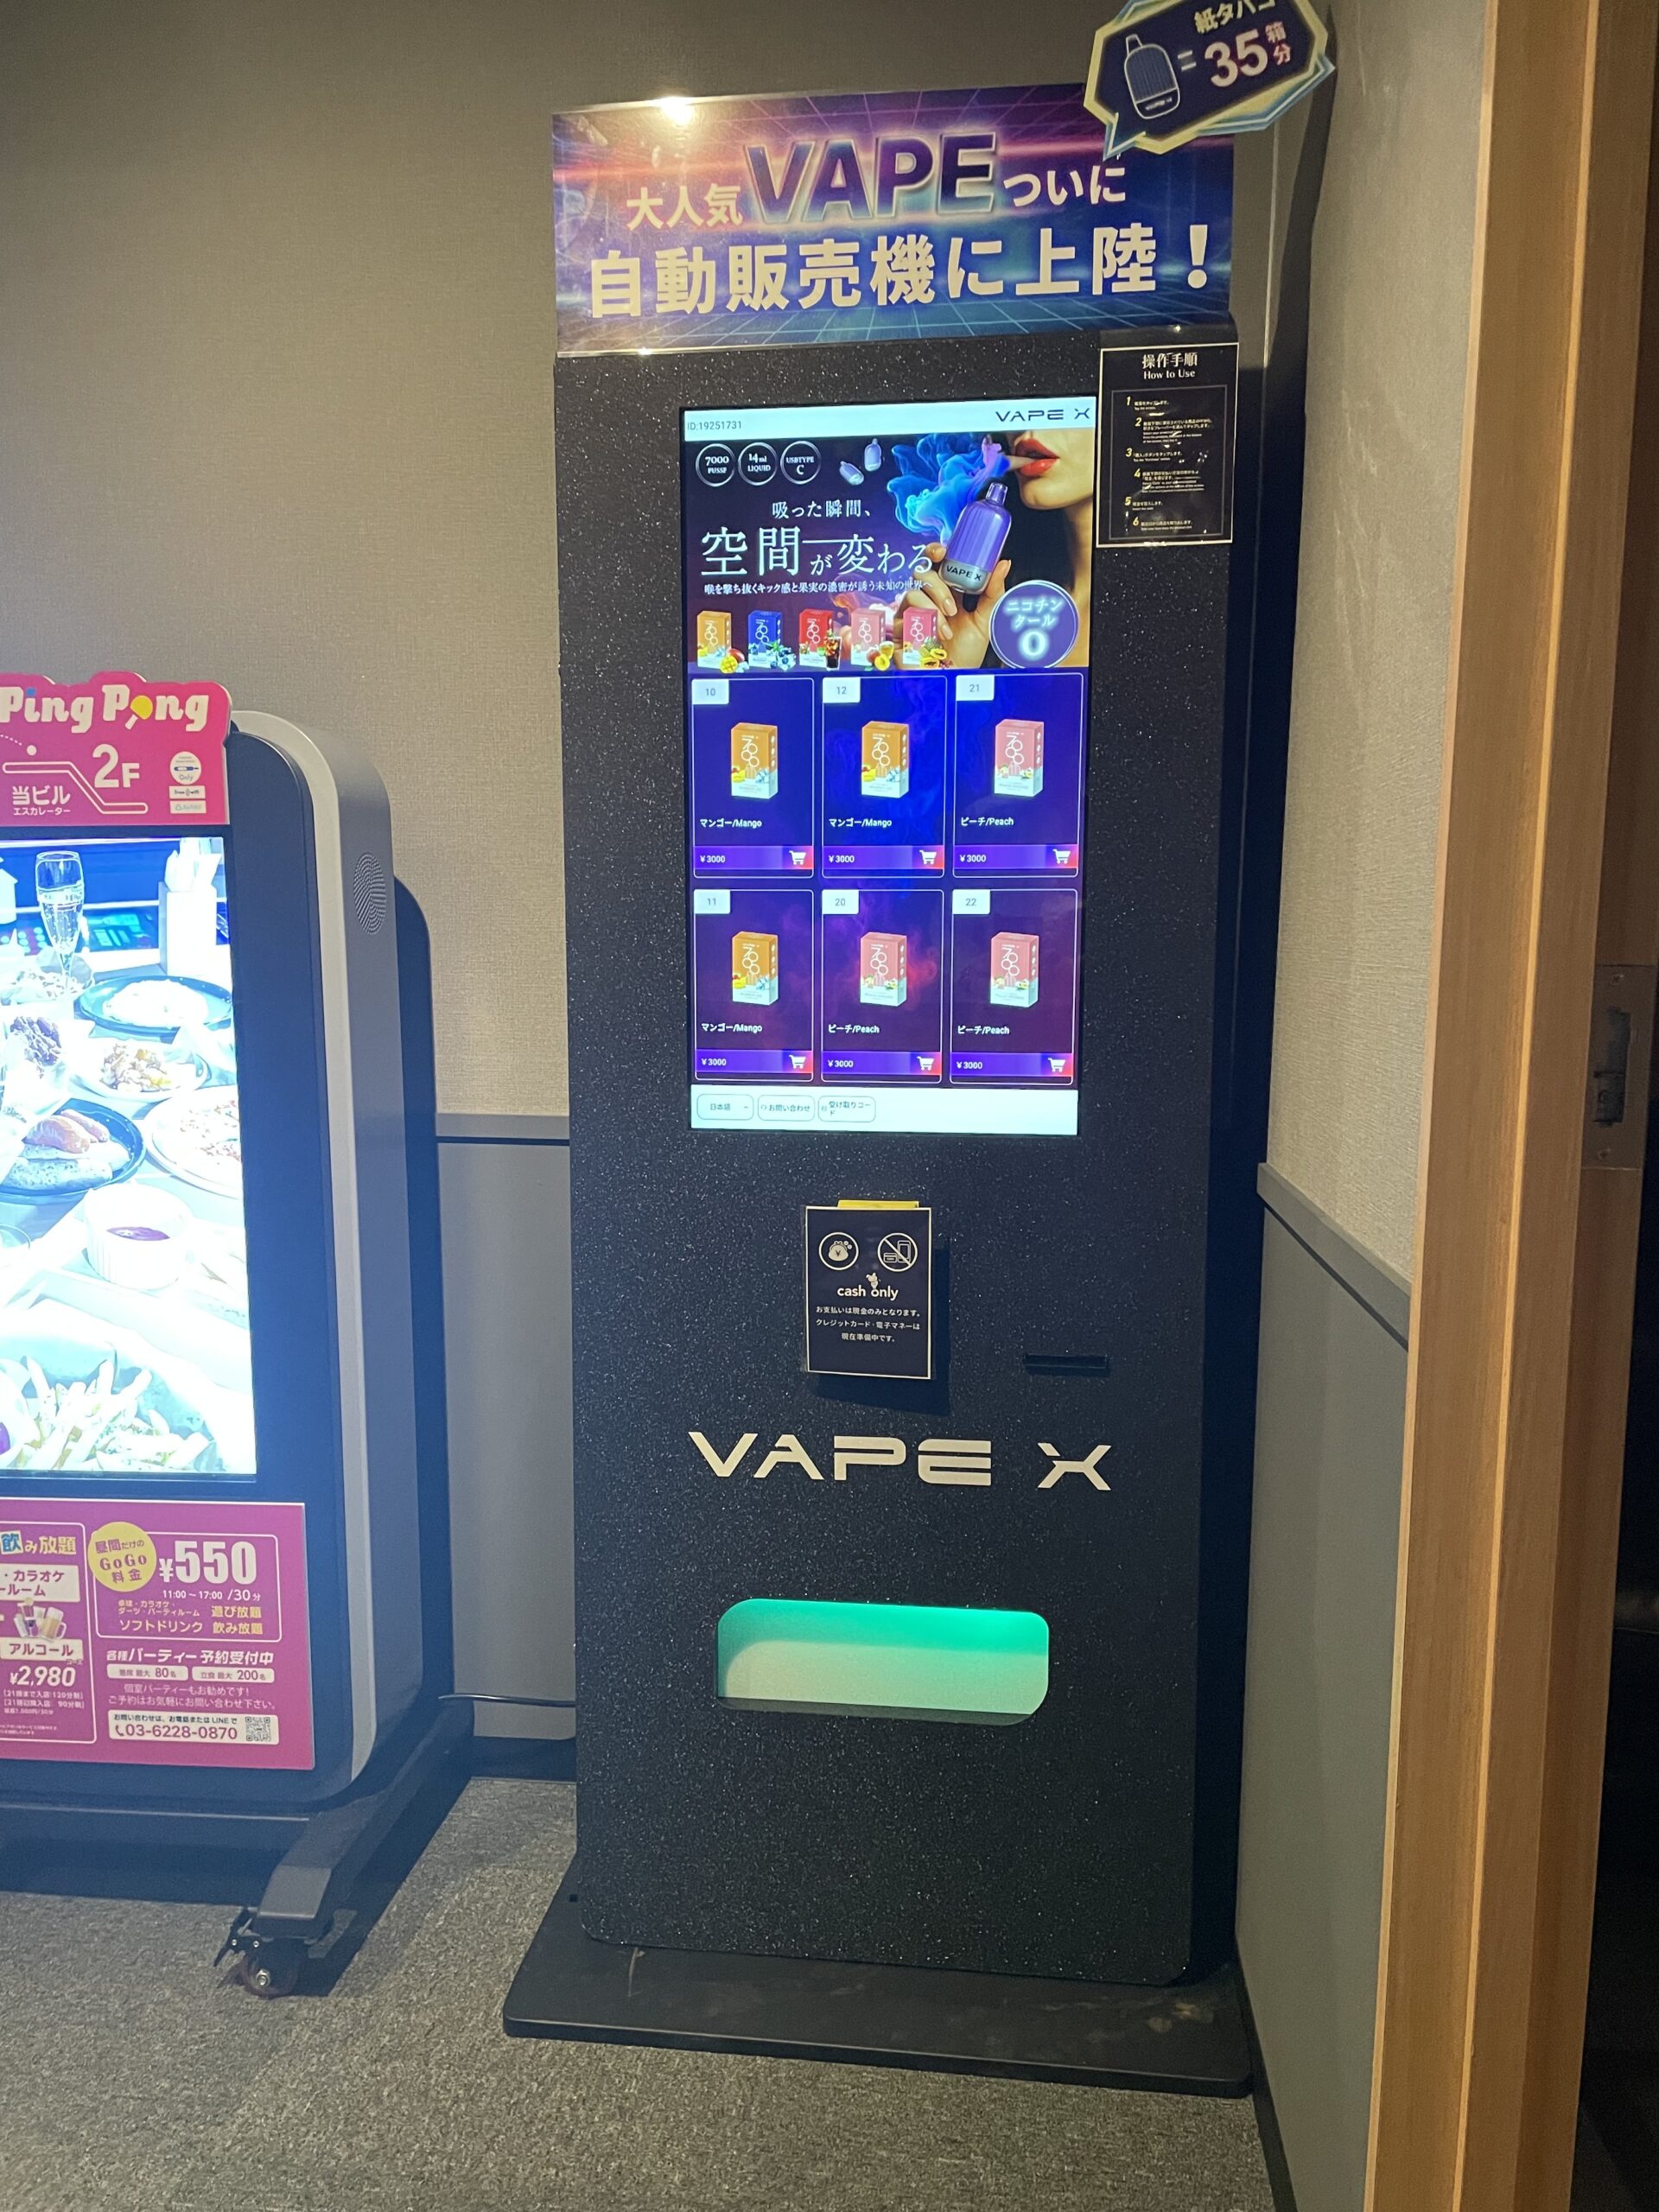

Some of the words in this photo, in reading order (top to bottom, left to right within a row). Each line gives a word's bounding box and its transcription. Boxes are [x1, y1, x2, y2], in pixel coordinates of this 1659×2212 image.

[1205, 29, 1268, 86] 35
[626, 184, 744, 232] 大人気
[743, 131, 998, 225] VAPE
[1004, 164, 1127, 208] ついに
[590, 222, 1211, 319] 自動販売機に上陸！
[1141, 353, 1198, 369] 操作手順
[1143, 371, 1163, 380] How
[1166, 371, 1175, 379] to
[1178, 369, 1196, 378] Use
[1127, 396, 1131, 406] 1
[687, 420, 742, 431] ID:19251731
[995, 409, 1065, 423] VAPE
[1074, 407, 1090, 420] X
[1135, 417, 1142, 427] 2
[1126, 448, 1133, 457] 3
[705, 455, 730, 466] 7000
[796, 465, 804, 474] C
[1134, 468, 1141, 478] 4
[1124, 497, 1132, 505] 5
[772, 499, 871, 519] 吸った瞬間、
[1133, 517, 1140, 526] 6
[701, 526, 933, 576] 空間が変わる
[946, 564, 973, 579] VAPE
[975, 573, 982, 582] X
[1007, 597, 1064, 613] ニコチン
[1014, 615, 1056, 628] タール
[1021, 631, 1046, 657] 0
[704, 688, 716, 696] 10
[836, 686, 847, 695] 12
[969, 683, 981, 692] 21
[0, 686, 94, 733] Ping
[92, 744, 140, 788] 2F
[12, 785, 71, 805] 当ビル
[13, 807, 71, 816] エスカレーター
[700, 817, 762, 829] マンゴー/Mango
[829, 817, 893, 828] マンゴー/Mango
[960, 816, 1014, 827] ピーチ/Peach
[707, 898, 716, 906] 11
[835, 898, 846, 906] 20
[965, 898, 976, 906] 22
[701, 1022, 763, 1033] マンゴー/Mango
[828, 1023, 880, 1034] ピーチ/Peach
[957, 1025, 1010, 1035] ピーチ/Peach
[709, 1103, 731, 1111] 日本語
[836, 1285, 867, 1297] cash
[871, 1285, 899, 1301] only
[816, 1306, 920, 1317] お支払いは現金のみとなります。
[688, 1431, 992, 1486] VAPE
[1037, 1442, 1112, 1491] X
[1, 1533, 77, 1554] 飲み放題
[99, 1554, 147, 1571] GoGo
[159, 1541, 257, 1585] ¥550
[111, 1568, 142, 1584] 料金
[162, 1590, 187, 1599] 11:00
[199, 1591, 223, 1599] 17:00
[211, 1605, 262, 1618] 遊び放題
[119, 1620, 203, 1633] ソフトドリンク
[213, 1622, 264, 1635] 飲み放題
[10, 1643, 73, 1656] アルコール
[10, 1665, 76, 1687] ¥2,980
[125, 1724, 238, 1739] 03-6228-0870
